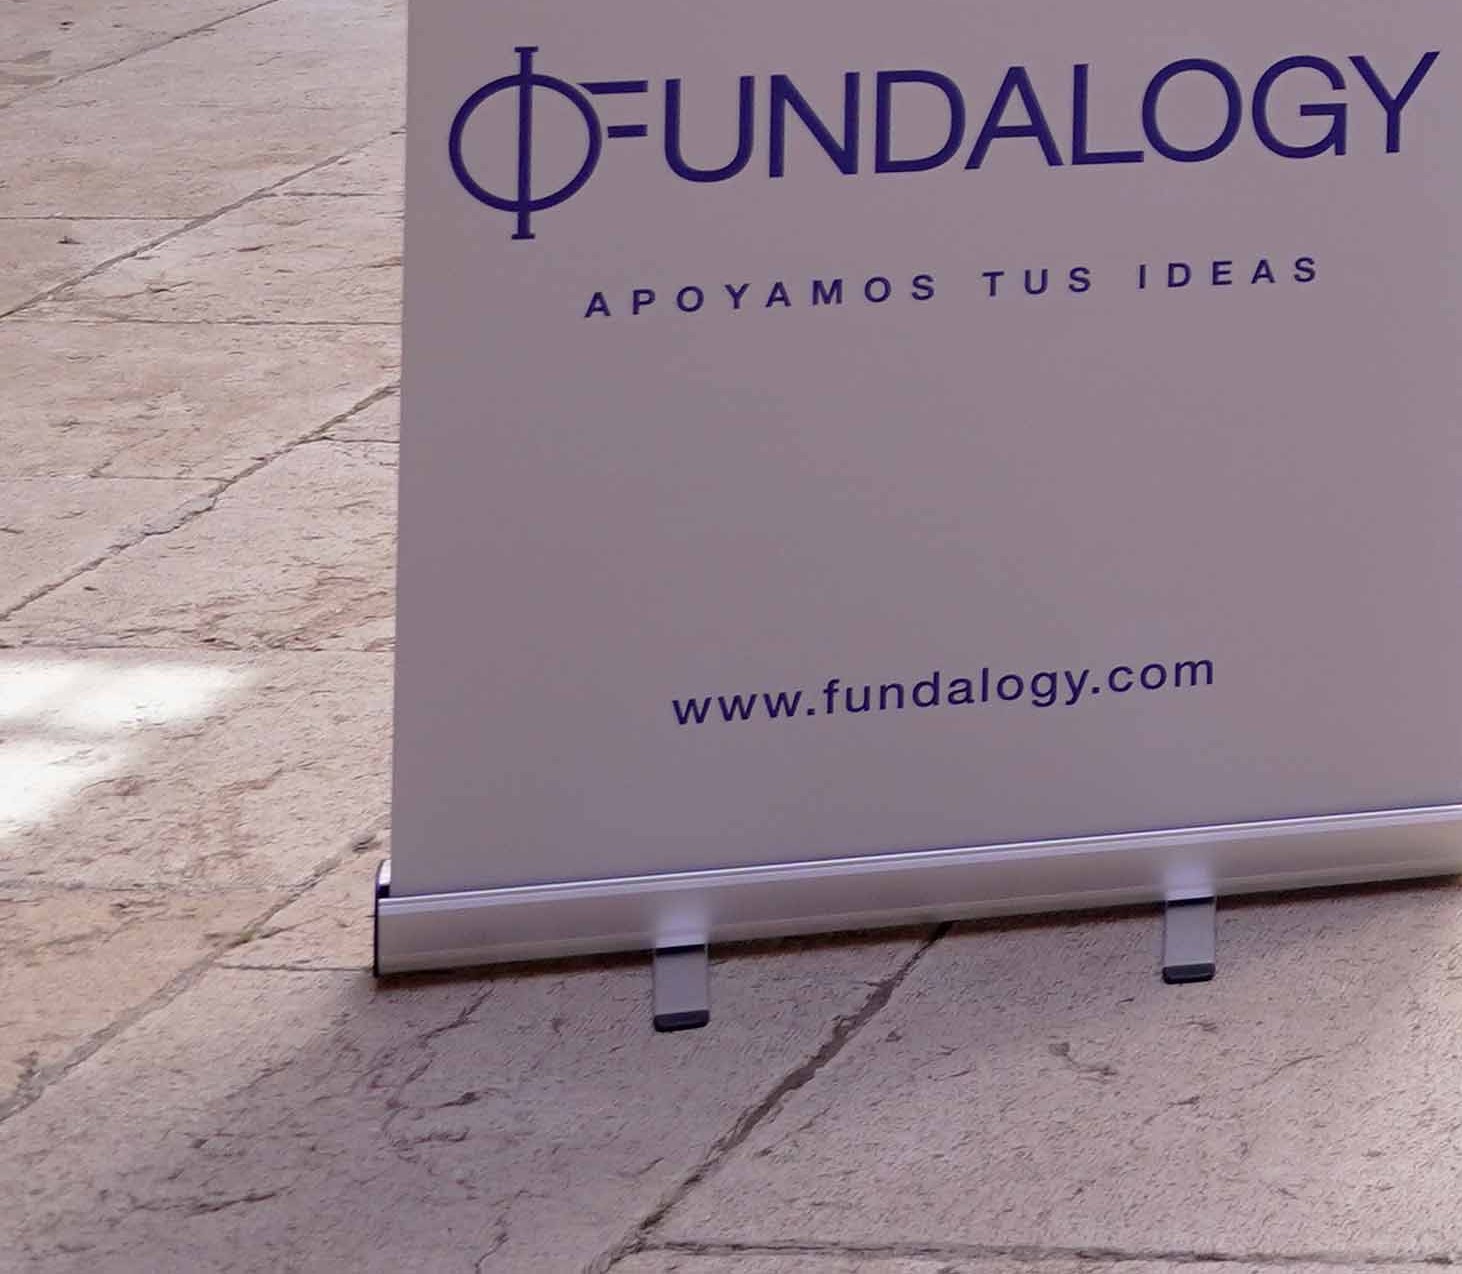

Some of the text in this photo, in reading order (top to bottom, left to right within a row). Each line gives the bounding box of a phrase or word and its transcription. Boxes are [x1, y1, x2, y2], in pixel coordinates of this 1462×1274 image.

[584, 51, 1440, 182] FUNDALOGY
[584, 257, 1315, 318] APOYAMOS TUS IDEAS
[672, 660, 1212, 725] www.fundalogy.com
